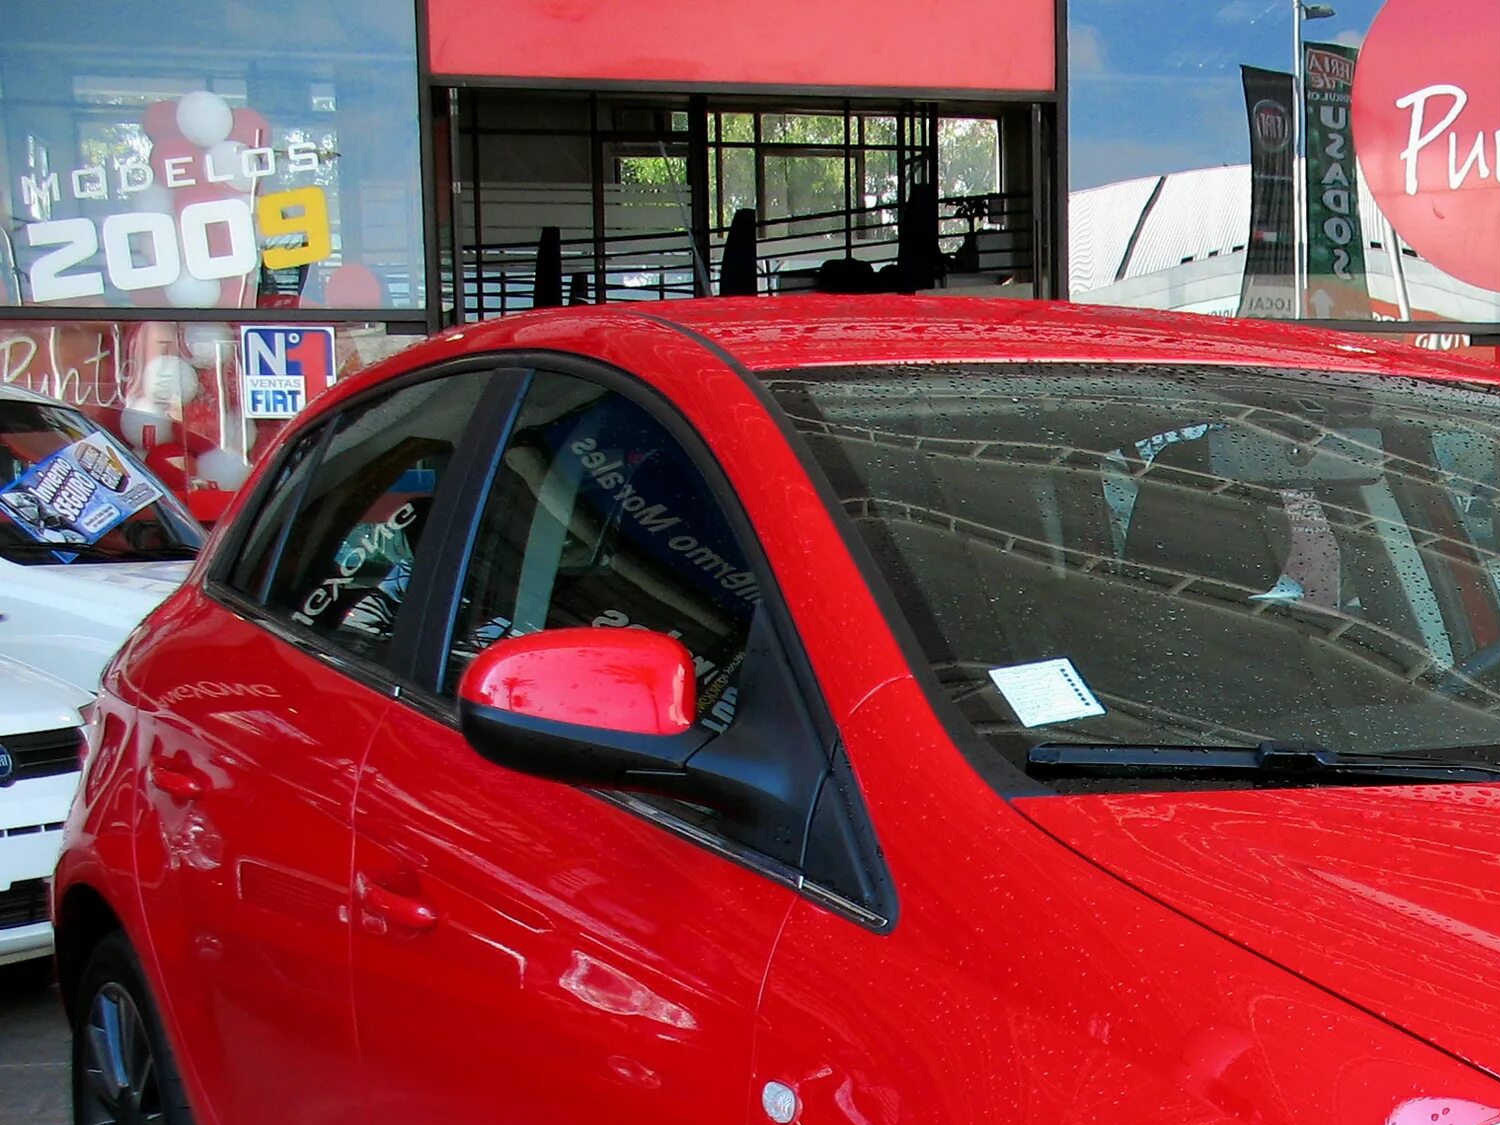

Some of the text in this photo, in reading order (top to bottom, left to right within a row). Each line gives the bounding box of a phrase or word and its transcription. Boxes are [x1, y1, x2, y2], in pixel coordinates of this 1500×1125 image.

[20, 142, 319, 205] MODELOS
[26, 186, 331, 302] 2009
[250, 379, 302, 388] VENTAS
[251, 389, 302, 413] FIAT
[53, 469, 98, 522] SEGURO
